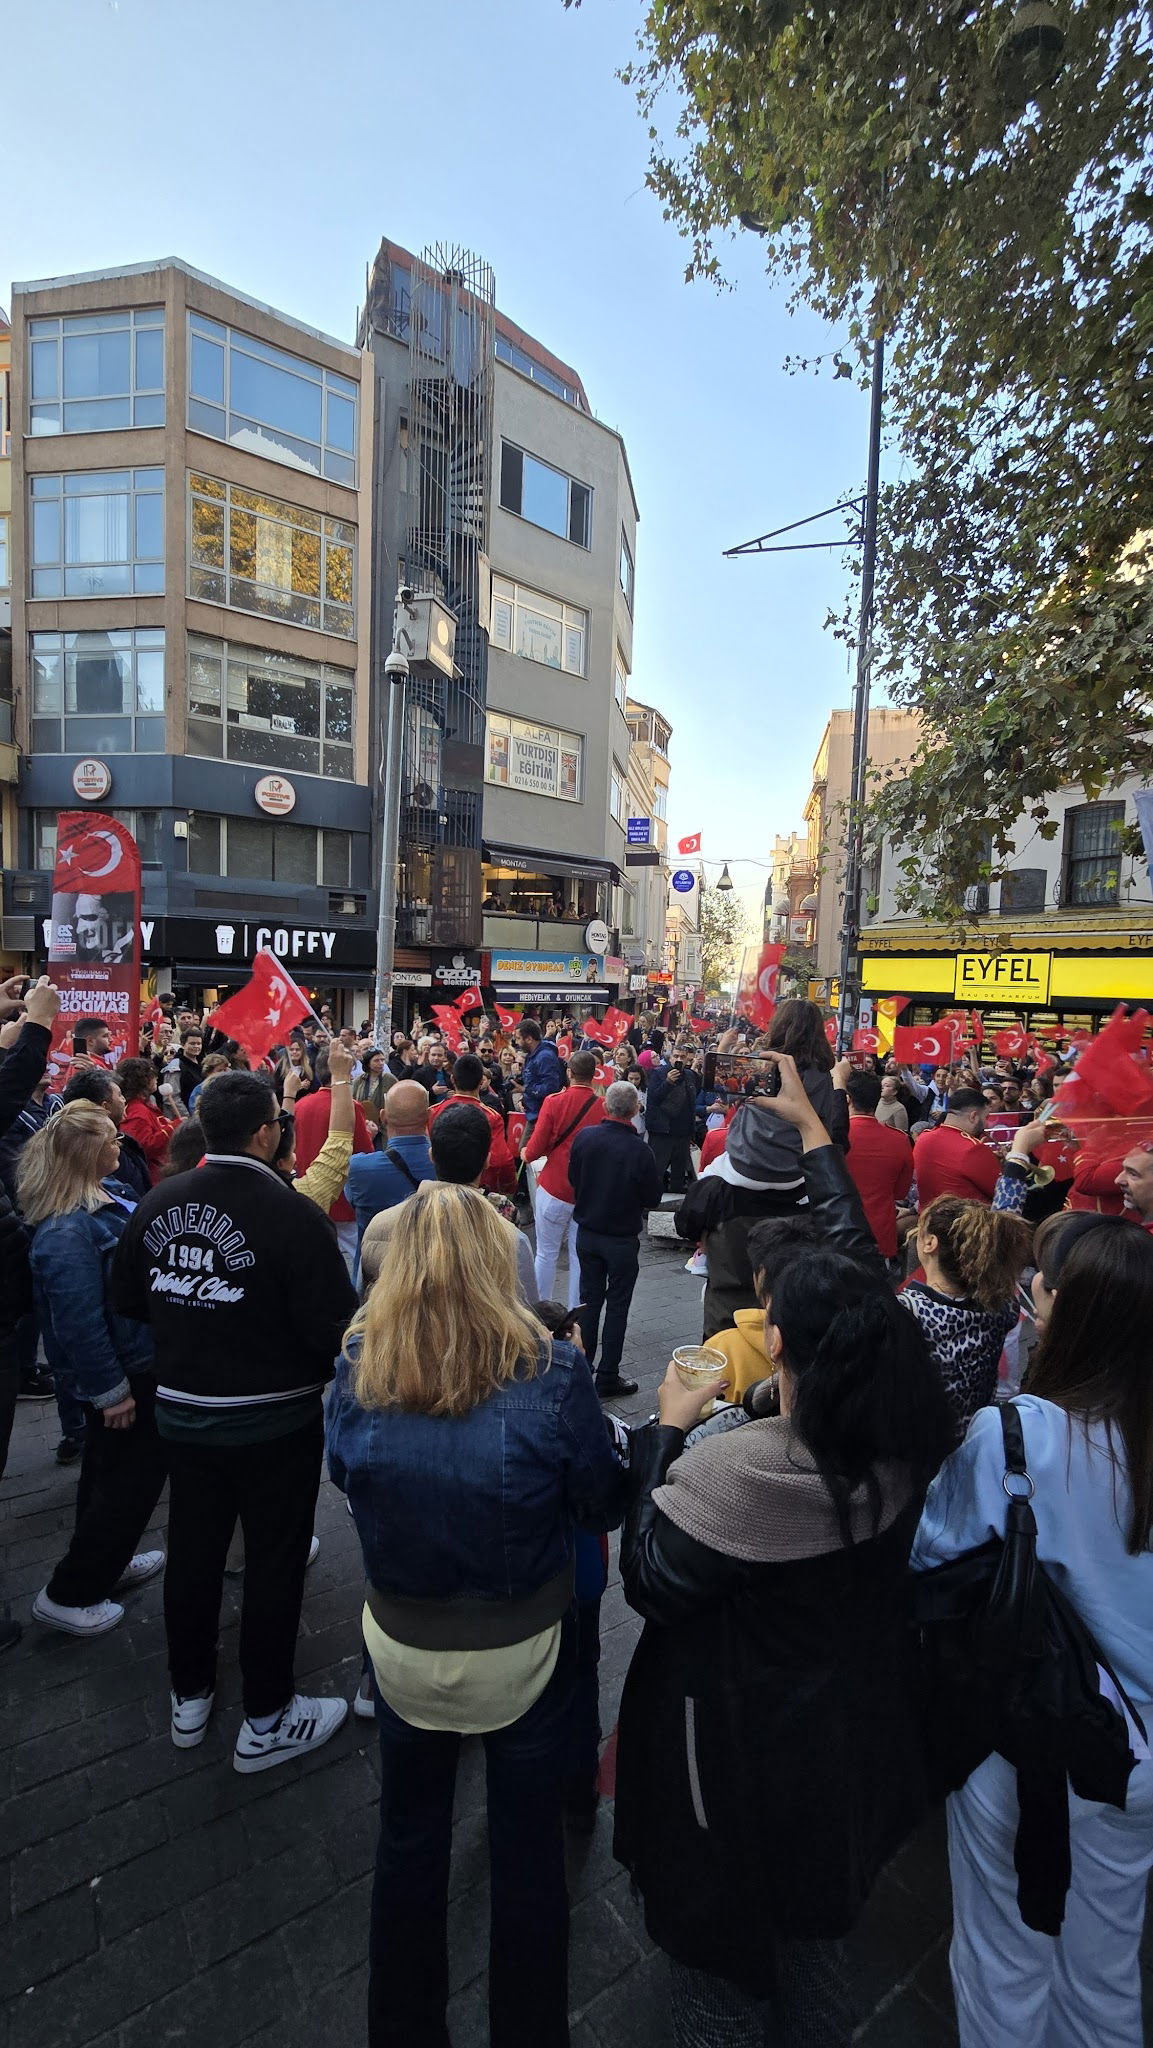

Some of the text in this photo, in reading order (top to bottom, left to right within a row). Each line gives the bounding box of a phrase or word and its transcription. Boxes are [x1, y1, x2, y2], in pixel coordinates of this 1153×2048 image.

[524, 726, 551, 743] ALFA
[515, 741, 556, 766] YURTDIŞI
[519, 760, 553, 781] EĞİTİM
[529, 779, 540, 788] 550
[540, 782, 548, 790] 00
[500, 858, 527, 869] MONTAG
[256, 927, 336, 958] COFFY
[868, 940, 892, 948] EYFEL
[435, 965, 481, 980] ÖZGÜR
[962, 958, 1040, 982] EYFEL
[565, 994, 592, 1002] OYUNCAK
[143, 1203, 256, 1272] UNDERDOG
[167, 1243, 214, 1273] 1994
[150, 1267, 245, 1302] World Class
